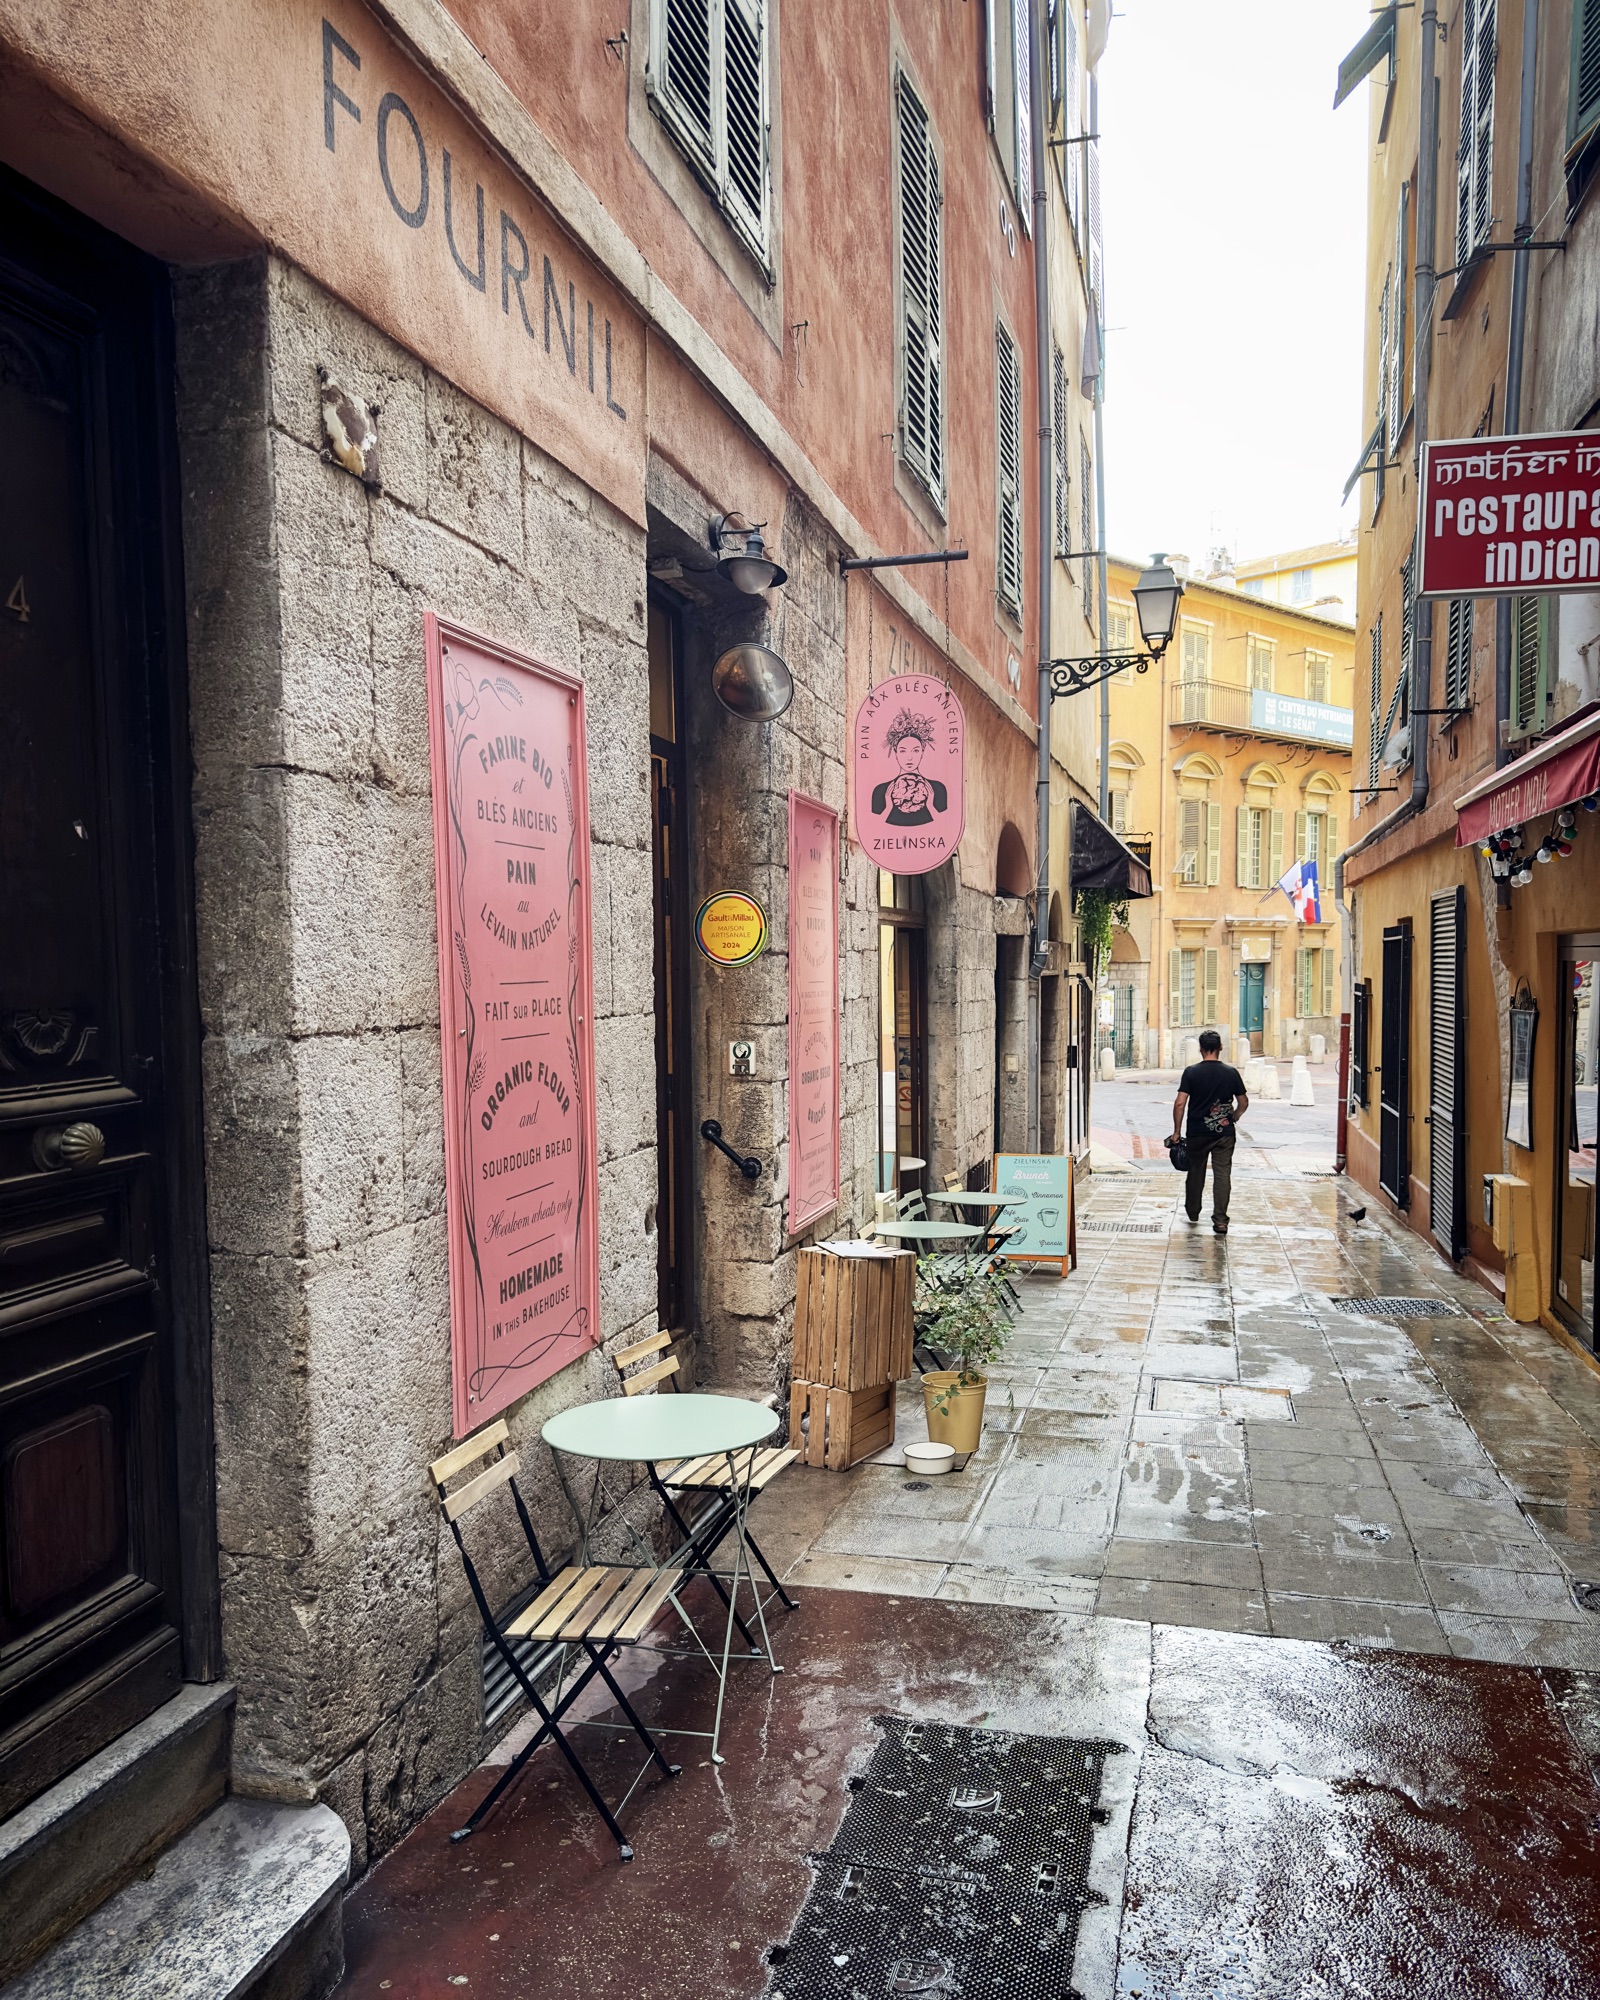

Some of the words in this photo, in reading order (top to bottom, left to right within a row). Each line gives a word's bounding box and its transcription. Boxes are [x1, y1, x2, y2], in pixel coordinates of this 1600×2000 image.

[322, 16, 626, 421] FOURNIL
[1434, 445, 1570, 485] mother
[5, 574, 31, 622] 4
[860, 725, 870, 759] PAIN
[866, 690, 889, 718] AUX
[895, 680, 929, 694] BLÉS
[933, 692, 959, 755] ANCIENS
[1278, 700, 1306, 716] CENTRE
[1307, 705, 1317, 718] DU
[1282, 715, 1292, 728] LE
[1292, 716, 1316, 732] SÉNAT
[479, 735, 527, 774] FARINE
[532, 747, 553, 790] BIO
[512, 776, 525, 794] et
[1488, 784, 1521, 832] MOTHER
[1522, 770, 1548, 818] INDIA
[477, 796, 506, 824] BLÉS
[512, 806, 558, 834] ANCIENS
[507, 859, 537, 886] PAIN
[480, 902, 517, 950] LEVAIN
[521, 908, 561, 951] NATUREL
[516, 900, 530, 913] au
[485, 1001, 510, 1022] FAIT
[513, 1005, 529, 1020] SUR
[532, 997, 562, 1017] PLACE
[481, 1060, 532, 1131] ORGANIC
[537, 1061, 570, 1117] FLOUR
[518, 1100, 540, 1128] and
[482, 1146, 541, 1180] SOURDOUGH
[545, 1137, 572, 1160] BREAD
[1012, 1169, 1050, 1180] Brunch
[1031, 1191, 1064, 1199] Cinnamon
[484, 1209, 529, 1244] Heirloom
[531, 1200, 556, 1224] wheats
[556, 1189, 573, 1224] only
[499, 1252, 564, 1304] HOMEMADE
[492, 1321, 502, 1342] IN
[505, 1316, 520, 1334] THIS
[522, 1284, 570, 1324] BAKEHOUSE
